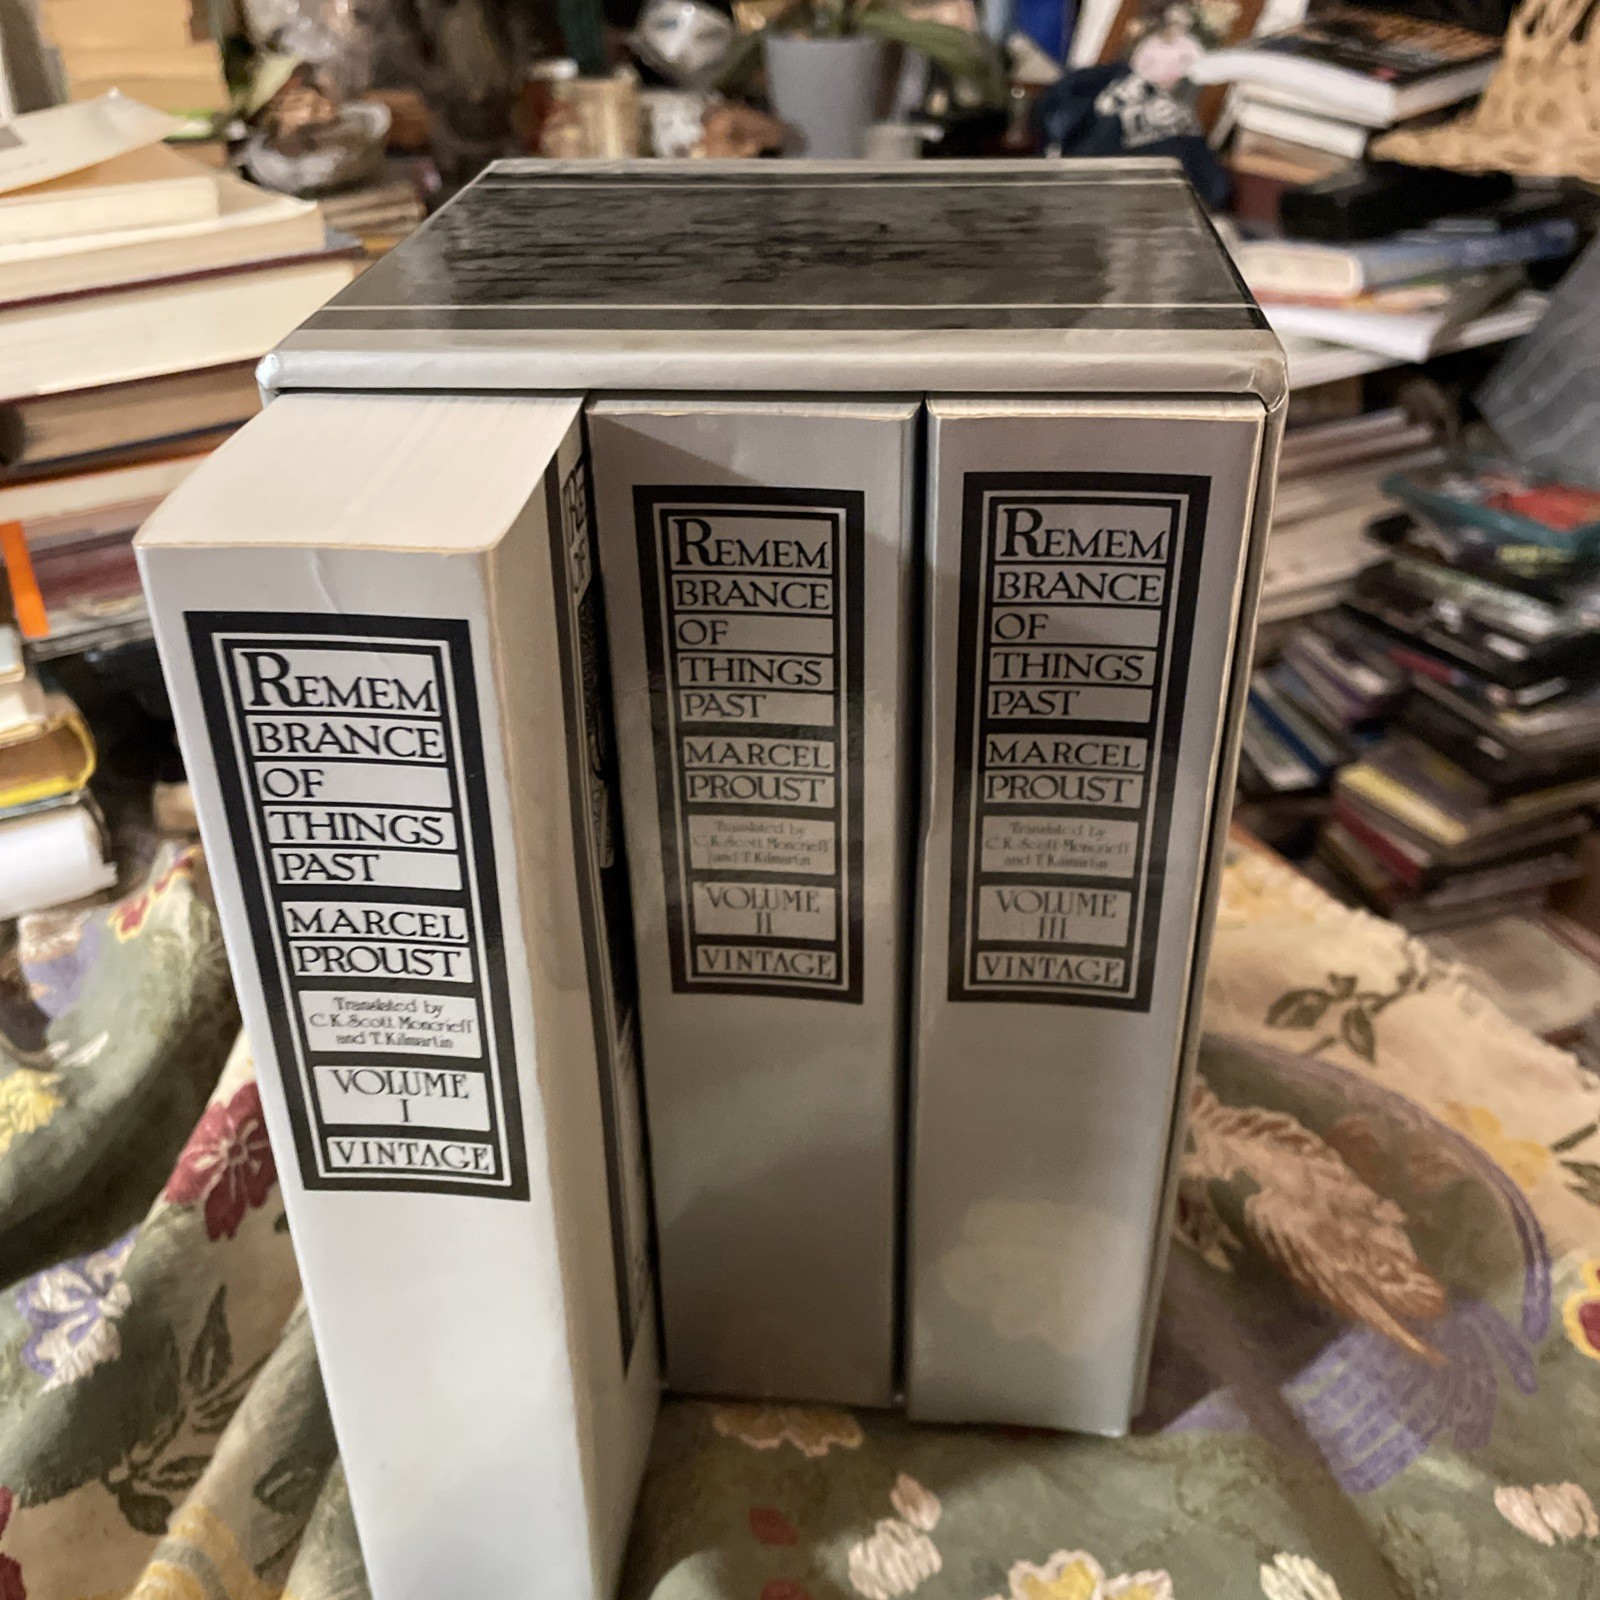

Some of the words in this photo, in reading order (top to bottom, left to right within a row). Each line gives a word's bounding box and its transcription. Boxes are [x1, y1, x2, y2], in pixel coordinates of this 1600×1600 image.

[672, 518, 829, 569] REMEM
[1000, 507, 1166, 560] REMEM
[675, 579, 829, 610] BRANCE
[997, 571, 1161, 602] BRANCE
[678, 619, 729, 645] OF
[994, 613, 1049, 640] OF
[680, 656, 823, 686] THINGS
[993, 652, 1145, 681] THINGS
[240, 651, 437, 713] REMEM
[684, 692, 767, 718] PAST
[991, 690, 1080, 716] PAST
[253, 722, 443, 758] BRANCE
[988, 740, 1141, 768] MARCEL
[685, 741, 831, 769] MARCEL
[262, 767, 326, 798] OF
[688, 774, 826, 802] PROUST
[986, 774, 1134, 803] PROUST
[269, 811, 444, 846] THINGS
[277, 853, 380, 882] PAST
[705, 886, 820, 914] VOLUME
[994, 889, 1117, 918] VOLUME
[286, 908, 464, 939] MARCEL
[756, 912, 773, 935] II
[1038, 916, 1069, 940] III
[294, 946, 461, 977] PROUST
[701, 949, 833, 978] VINTAGE
[982, 955, 1121, 985] VINTAGE
[333, 996, 417, 1013] Translated
[424, 1000, 445, 1018] by
[331, 1069, 470, 1099] VOLUME
[399, 1098, 410, 1123] I
[332, 1140, 492, 1172] VINTAGE
